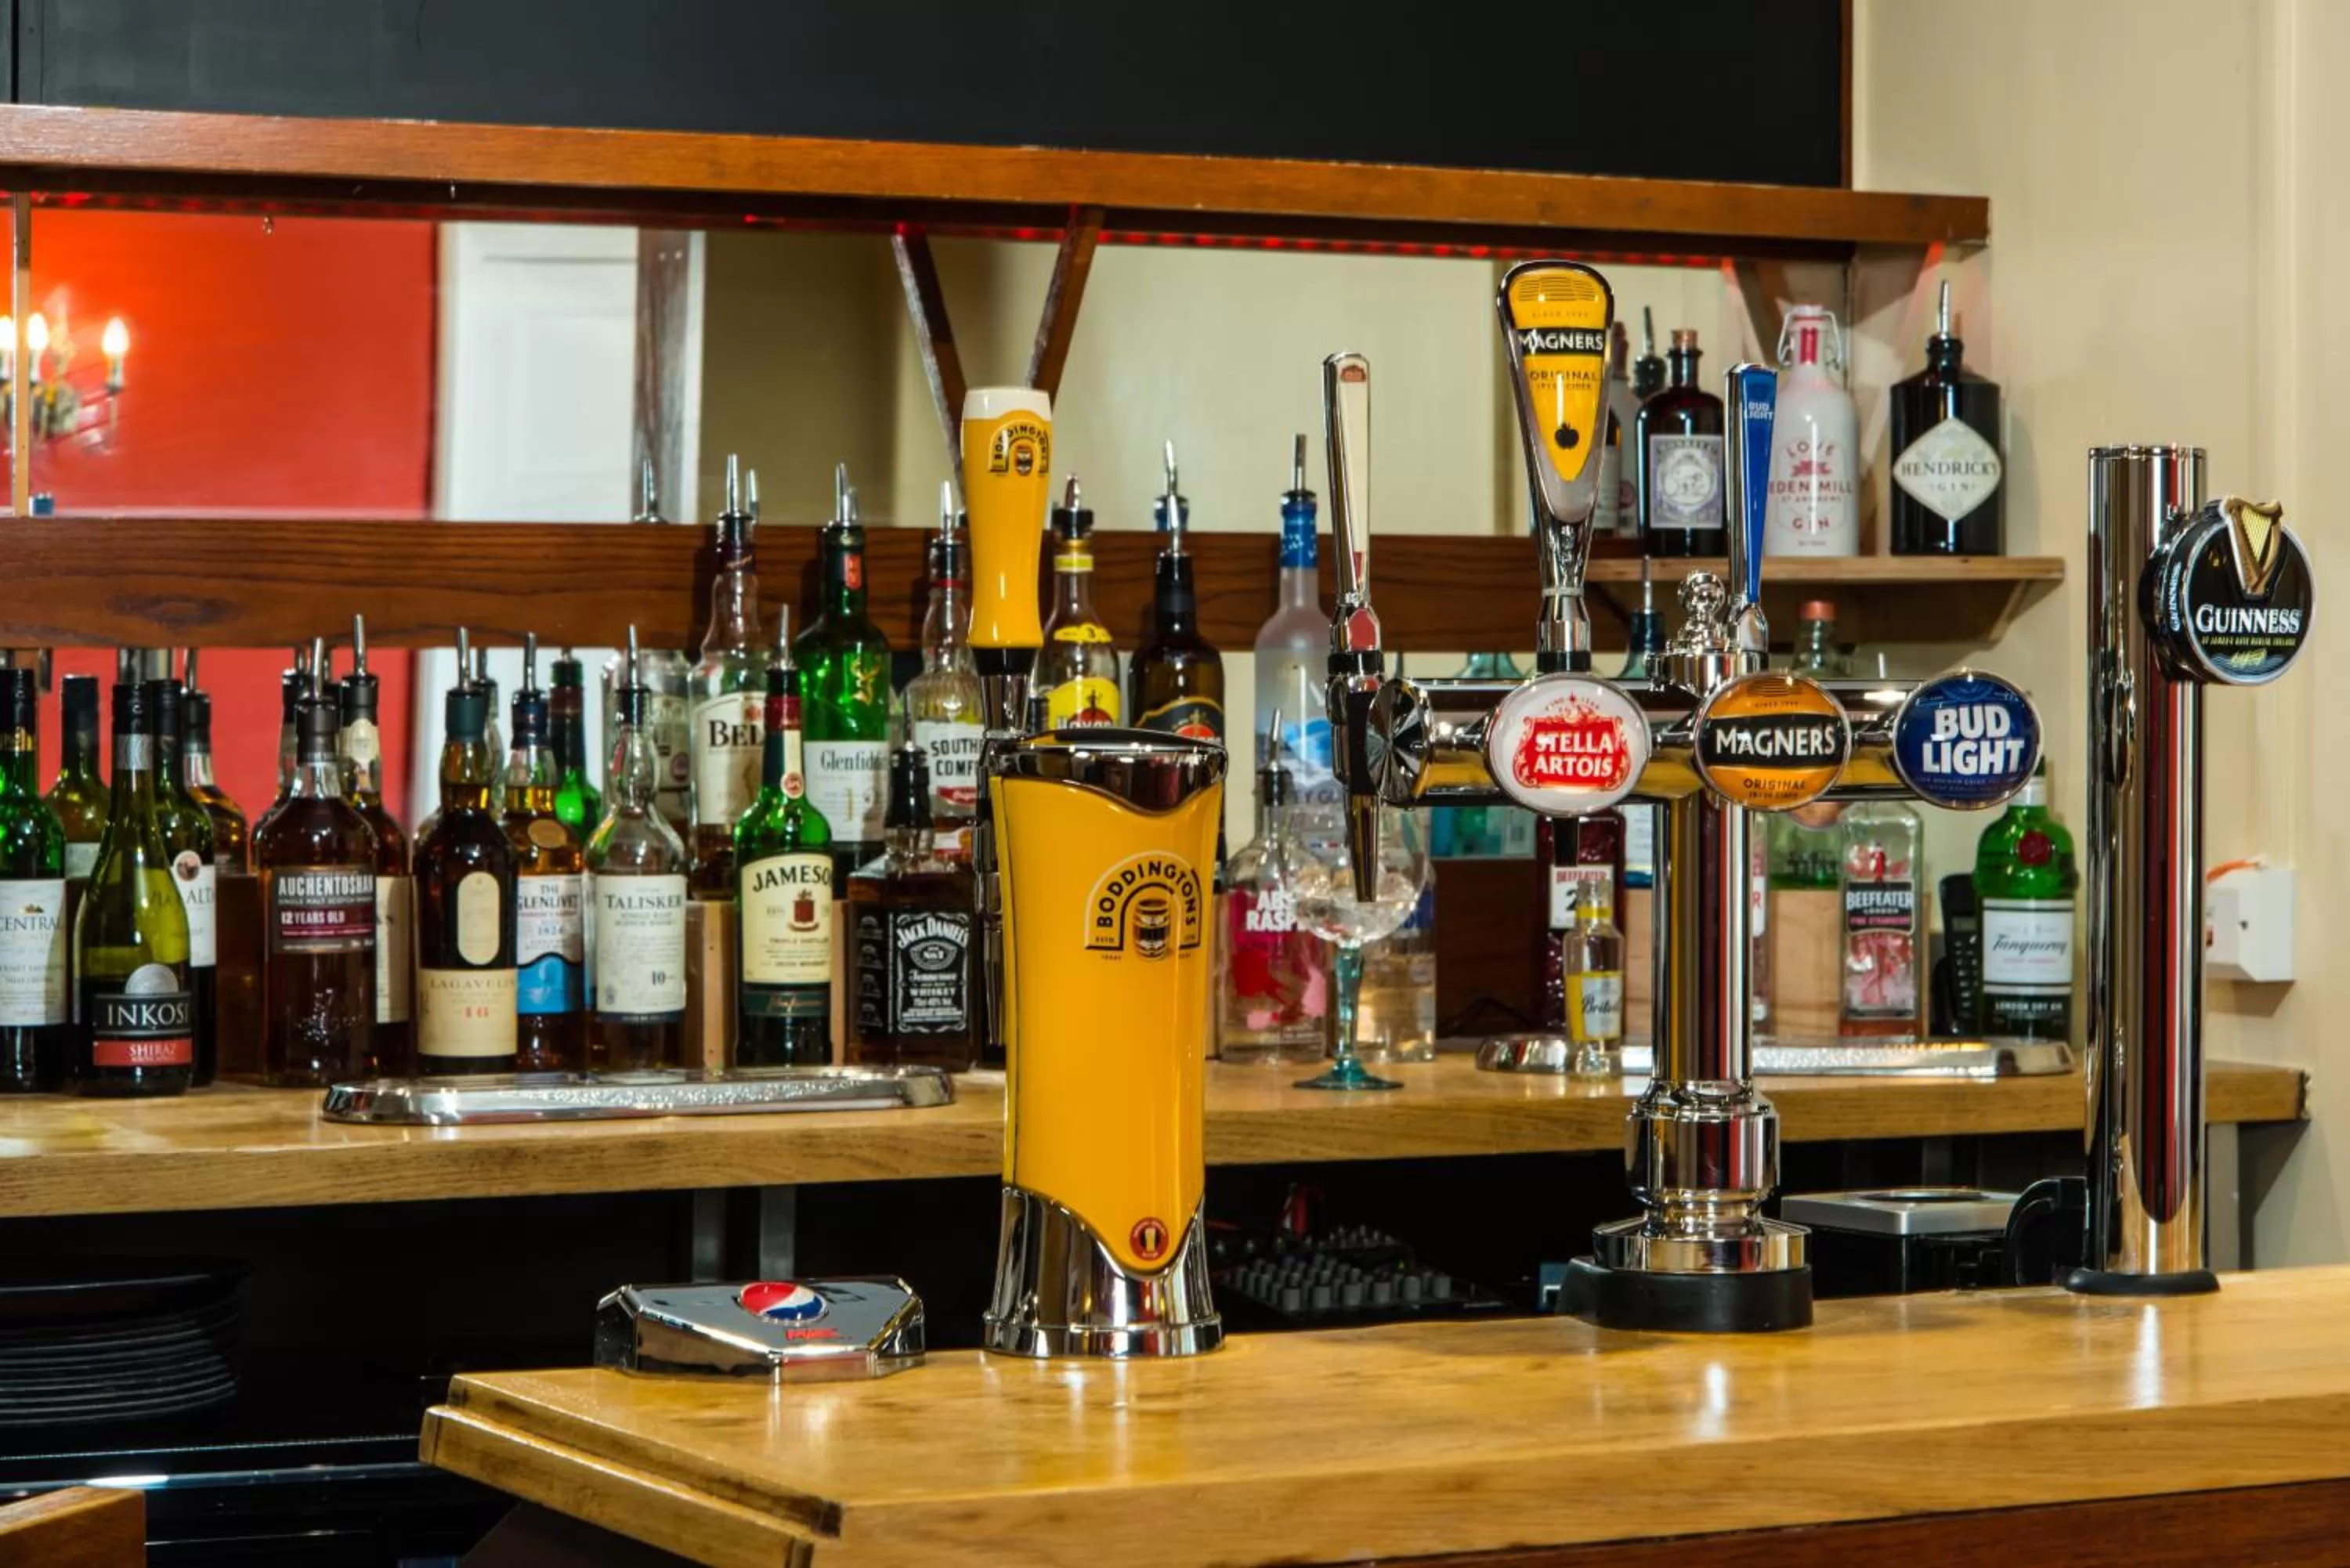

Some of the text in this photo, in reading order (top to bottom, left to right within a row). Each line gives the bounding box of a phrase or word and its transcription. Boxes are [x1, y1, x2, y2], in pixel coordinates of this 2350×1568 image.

[1518, 331, 1603, 351] MAGNERS
[2196, 604, 2301, 634] GUINNESS
[1935, 703, 2011, 739] BUD
[1535, 730, 1614, 753] STELLA
[1716, 724, 1836, 757] MAGNERS
[1535, 755, 1613, 777] ARTOIS
[1922, 739, 2025, 775] LIGHT
[1744, 778, 1806, 789] ORIGINAL
[278, 875, 374, 896] AUCHENTOSHAN
[1097, 861, 1196, 927] BODDINGTONS
[1846, 891, 1914, 910] BEEFEATER
[295, 911, 324, 924] YEARS
[652, 971, 665, 985] 10
